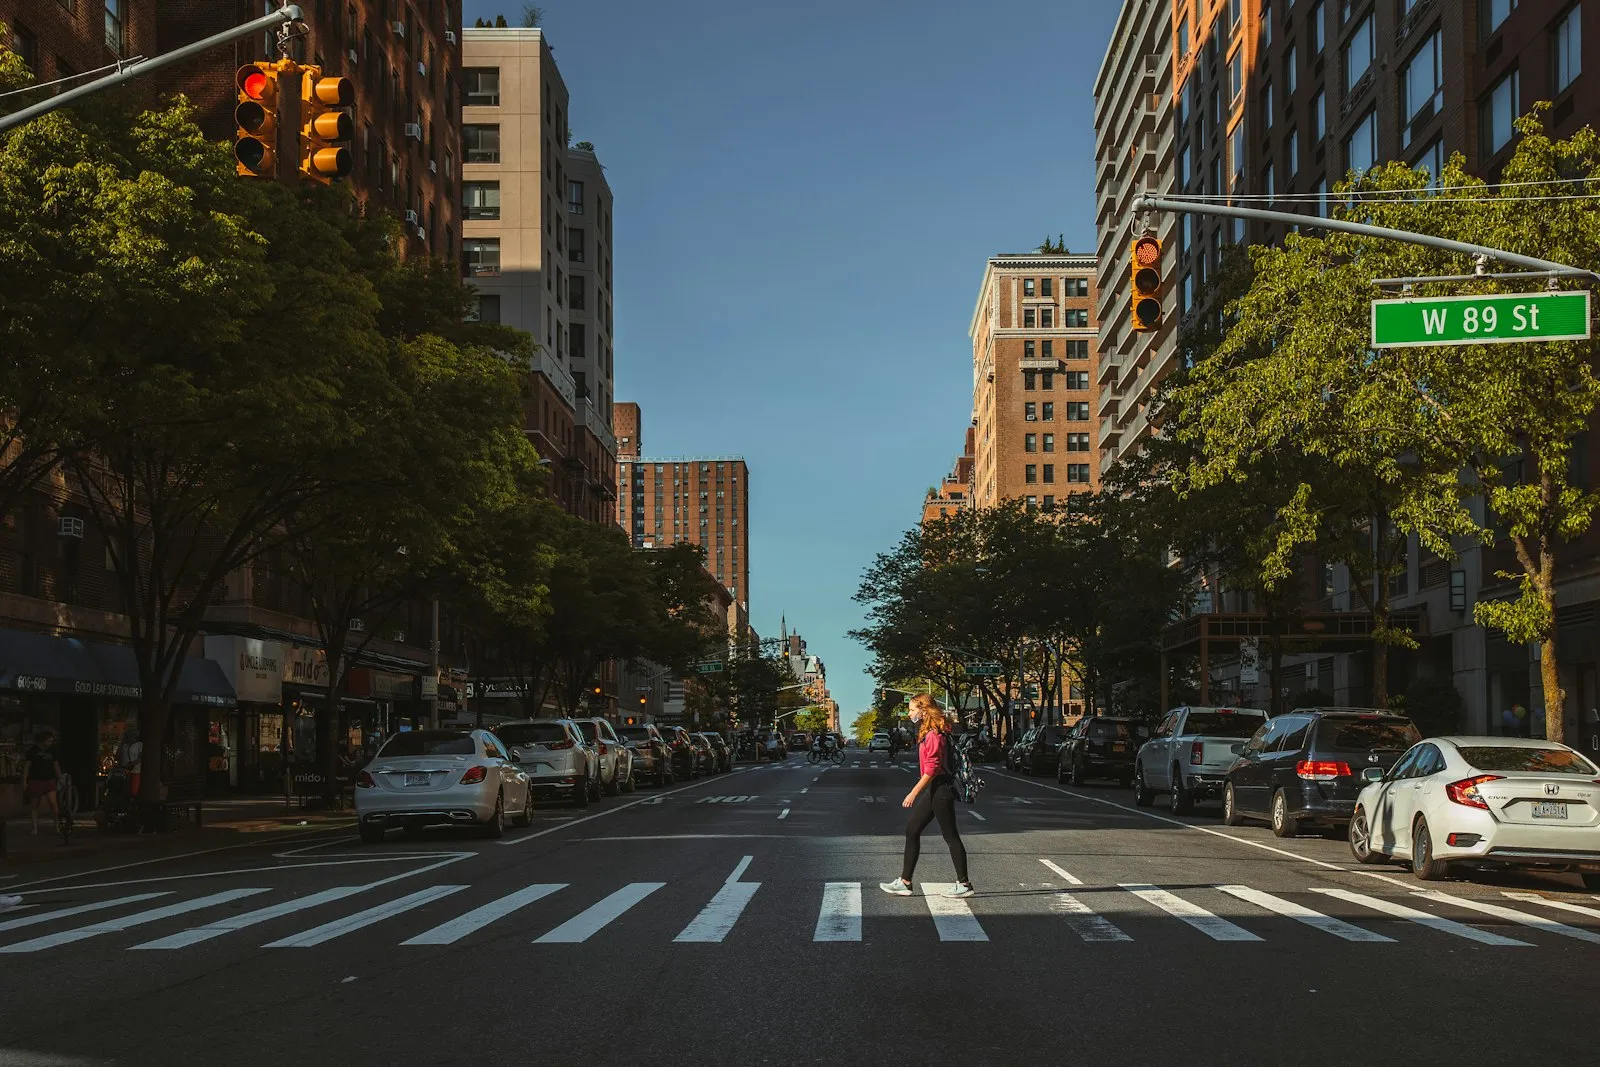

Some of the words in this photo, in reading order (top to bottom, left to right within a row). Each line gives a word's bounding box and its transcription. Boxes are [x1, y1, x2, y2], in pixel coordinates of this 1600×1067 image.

[1422, 309, 1448, 335] W
[1463, 306, 1498, 333] 89
[1512, 304, 1540, 331] St
[295, 772, 320, 783] mido
